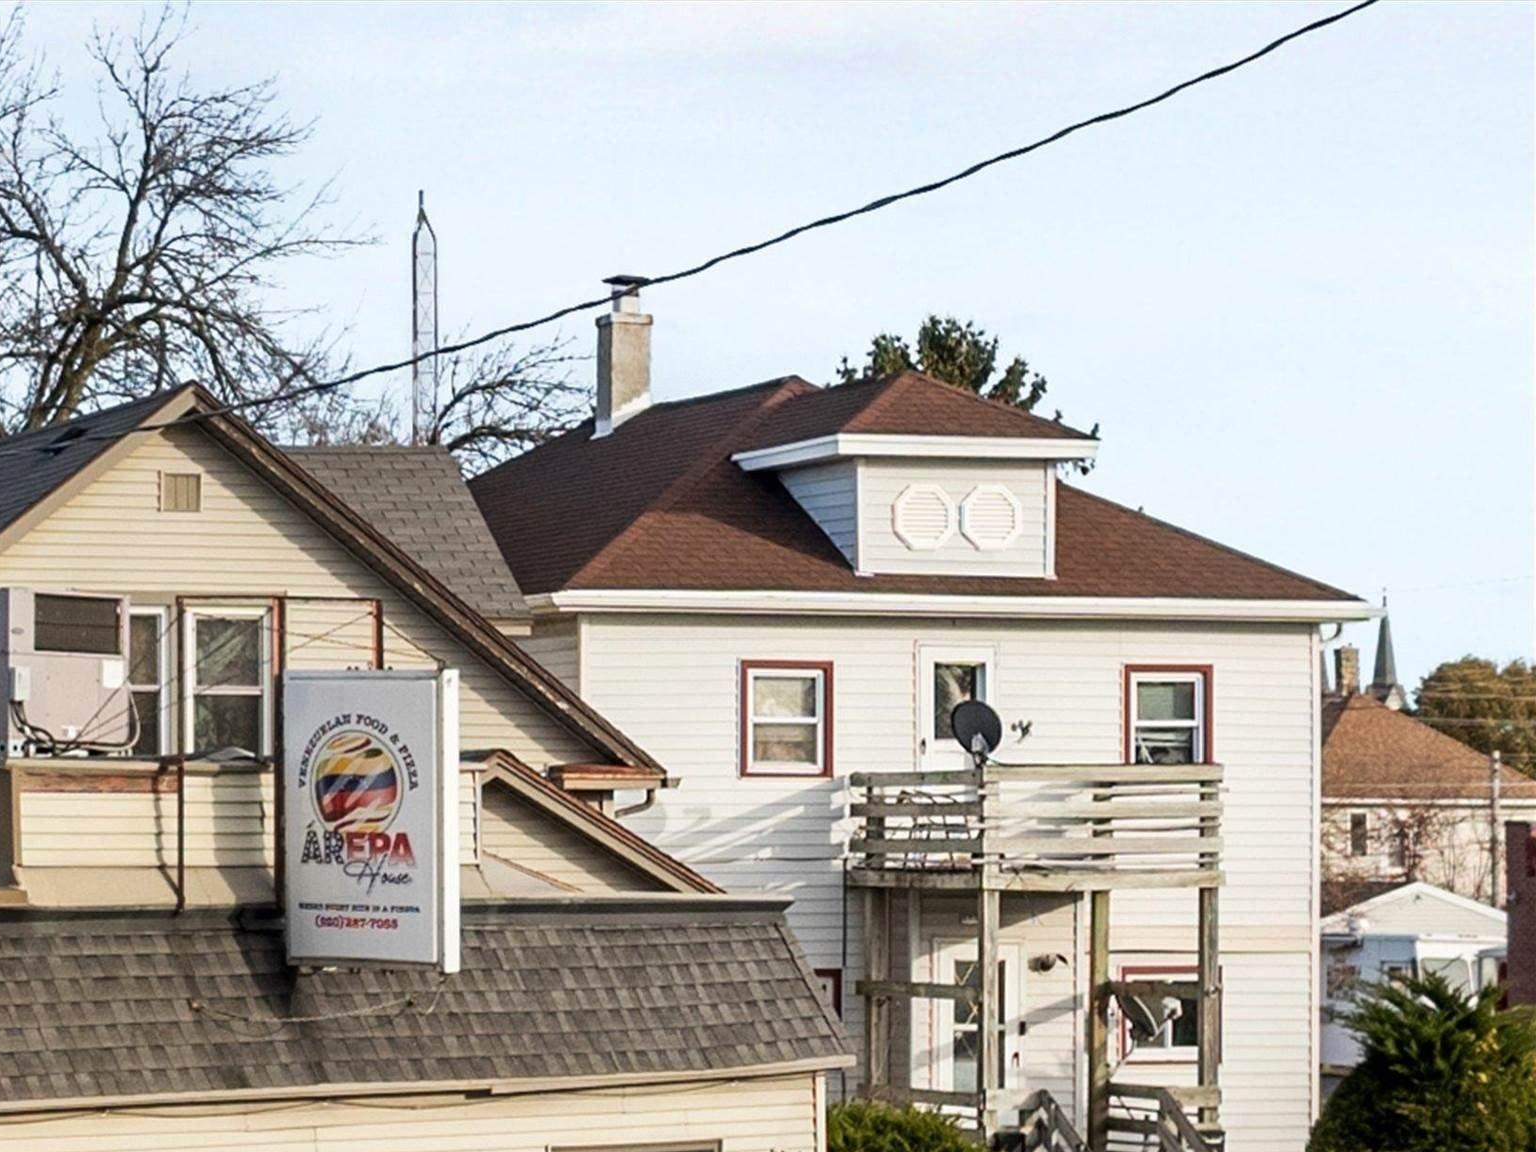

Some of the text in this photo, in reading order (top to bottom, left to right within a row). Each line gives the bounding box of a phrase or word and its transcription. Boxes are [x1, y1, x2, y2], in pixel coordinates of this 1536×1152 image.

[298, 713, 419, 792] VENEZUELAN FOOD & PIZZA
[343, 853, 412, 895] House
